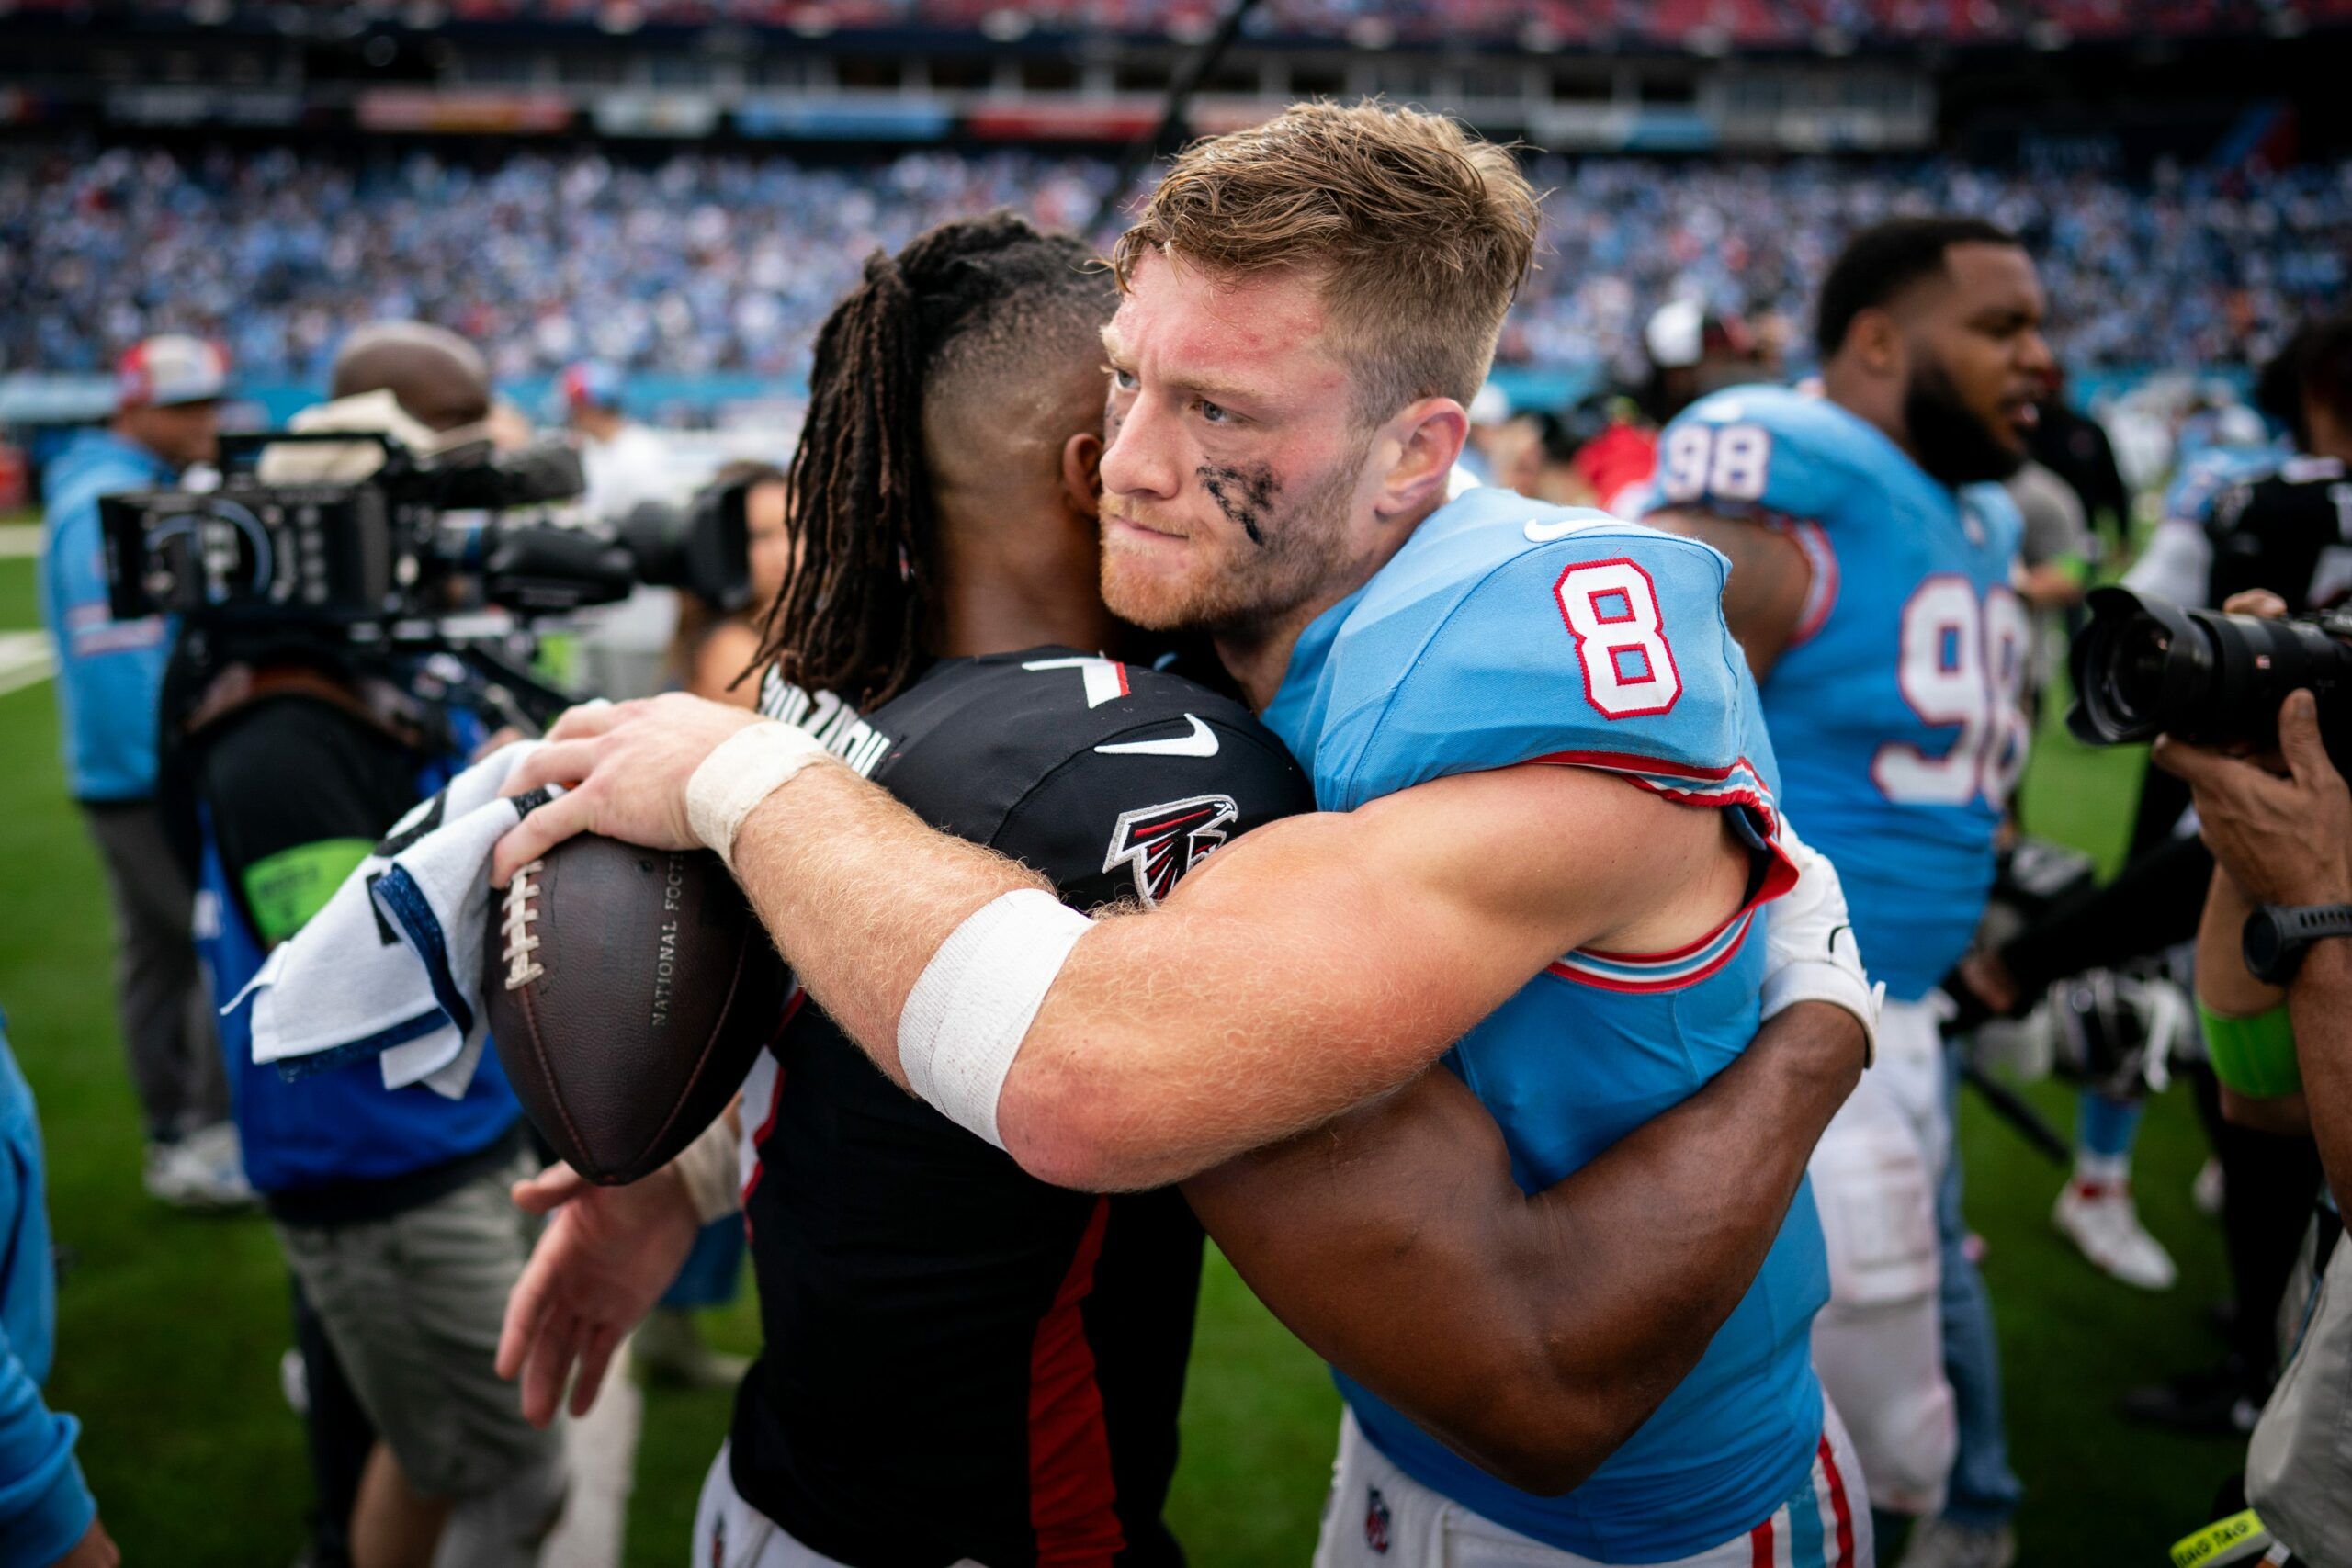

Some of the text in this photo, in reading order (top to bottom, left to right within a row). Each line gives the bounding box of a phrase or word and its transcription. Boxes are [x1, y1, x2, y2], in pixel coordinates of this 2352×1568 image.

[1664, 422, 1771, 502] 98
[1553, 557, 1683, 721] 8
[1869, 571, 2031, 813] 98
[651, 919, 678, 1027] NATIONAL
